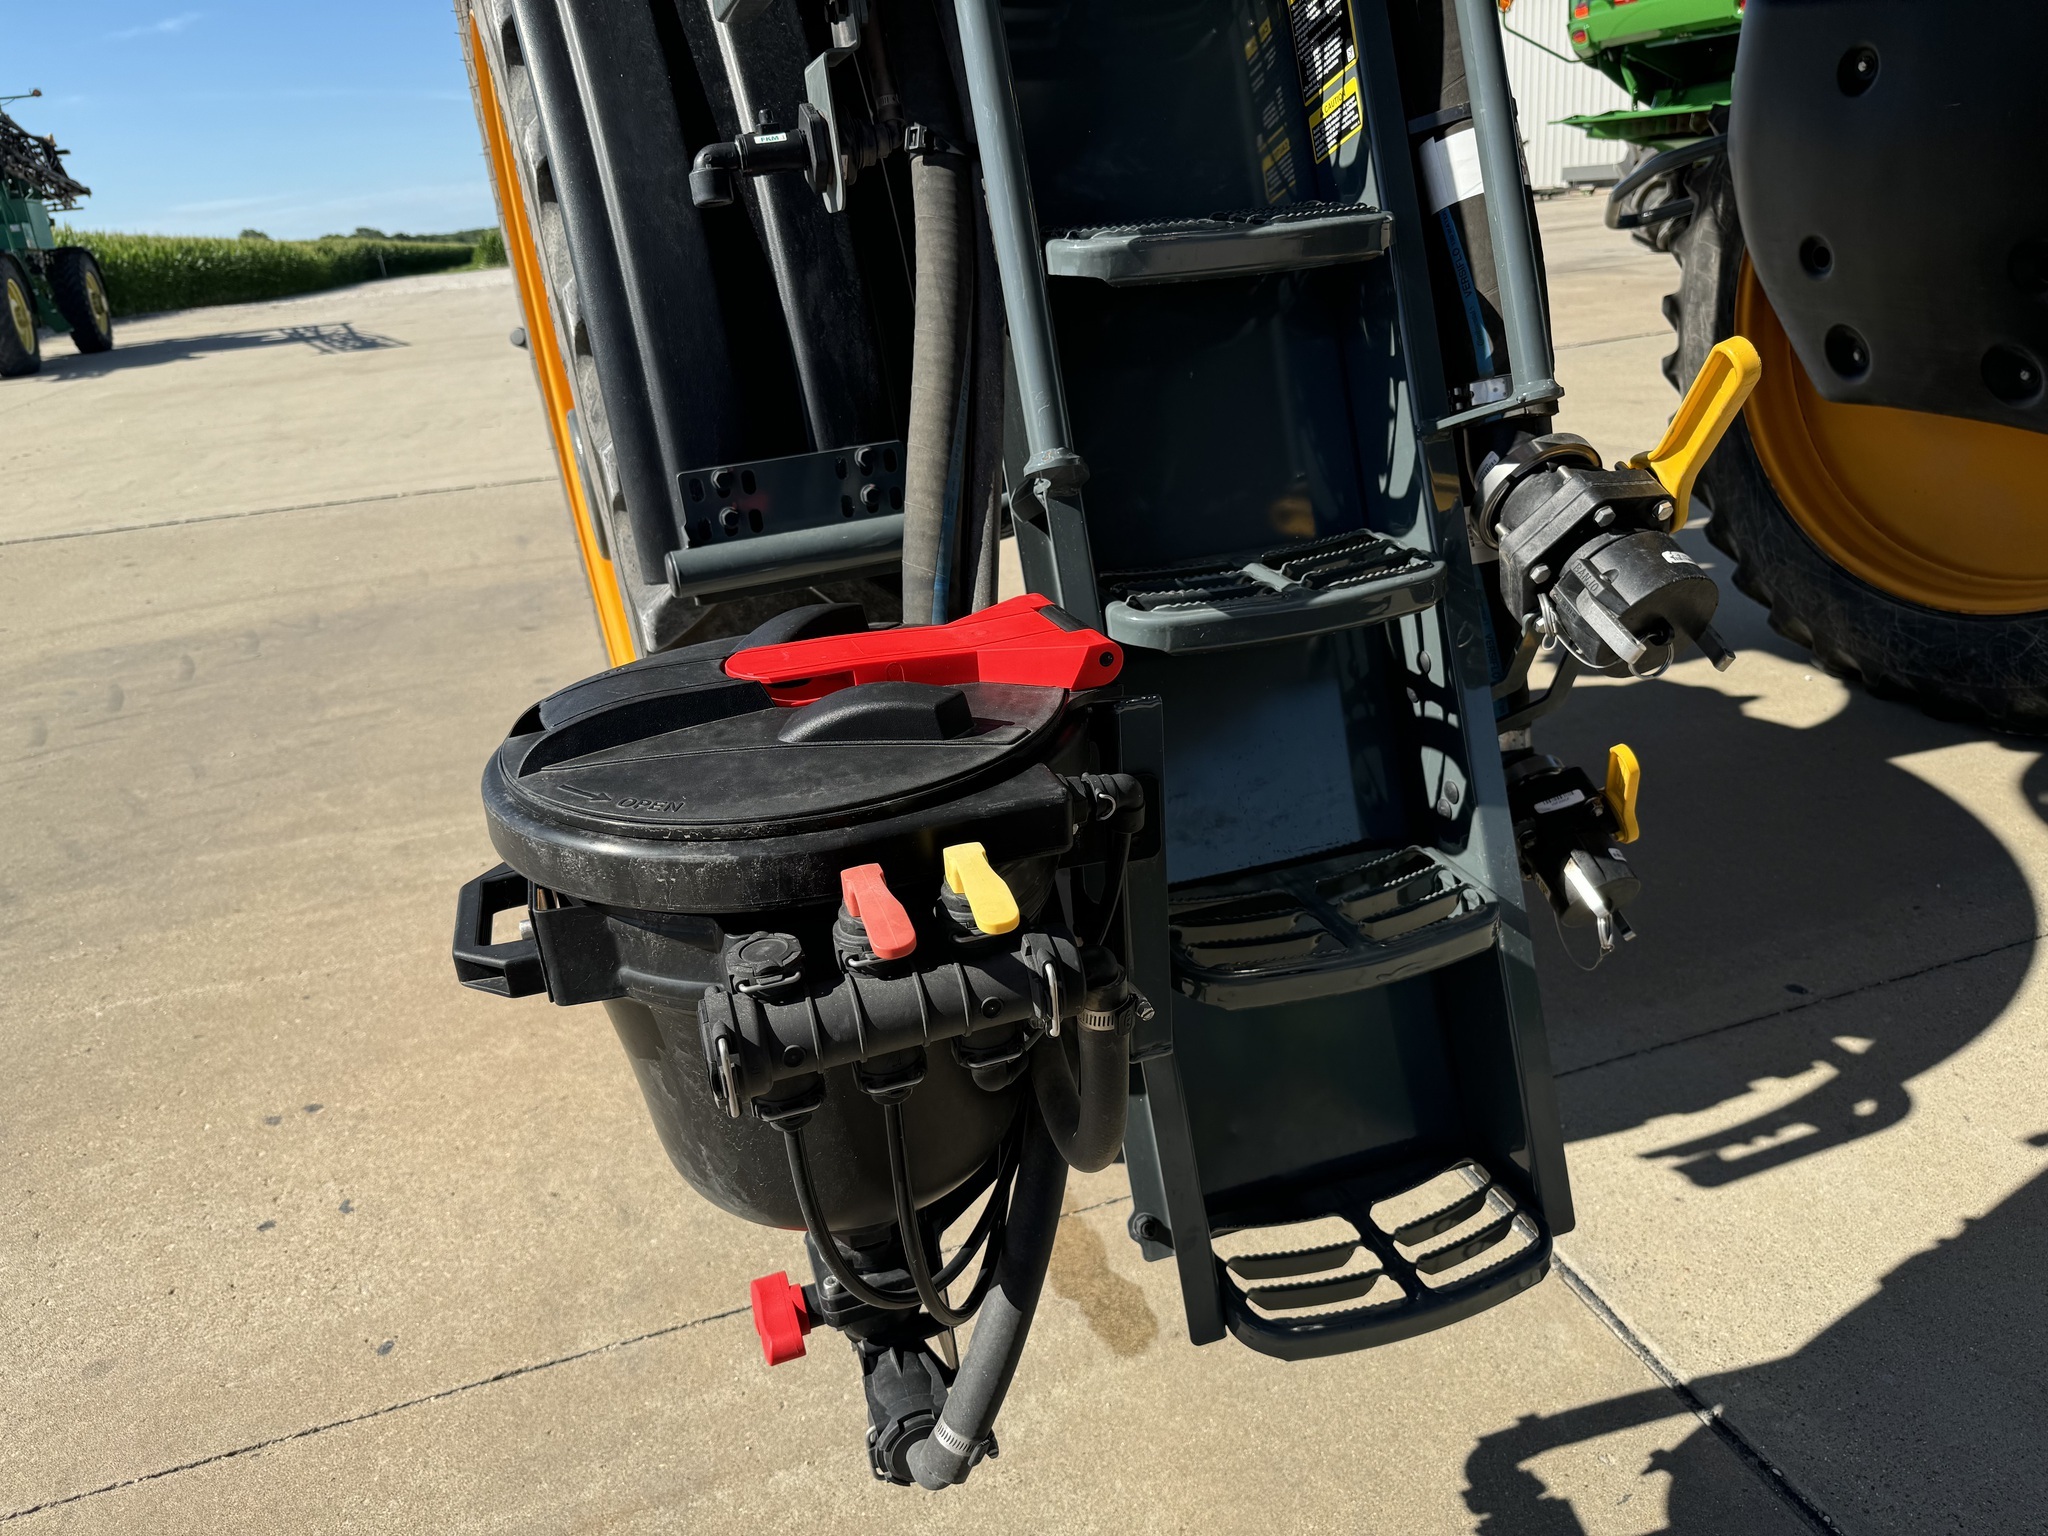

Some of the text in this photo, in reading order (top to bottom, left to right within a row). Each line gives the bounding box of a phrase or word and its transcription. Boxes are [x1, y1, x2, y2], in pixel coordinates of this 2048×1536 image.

[1324, 92, 1346, 113] CAUTION
[1452, 248, 1472, 298] VERSIFLO
[1573, 563, 1599, 591] BANJO
[616, 797, 685, 812] OPEN
